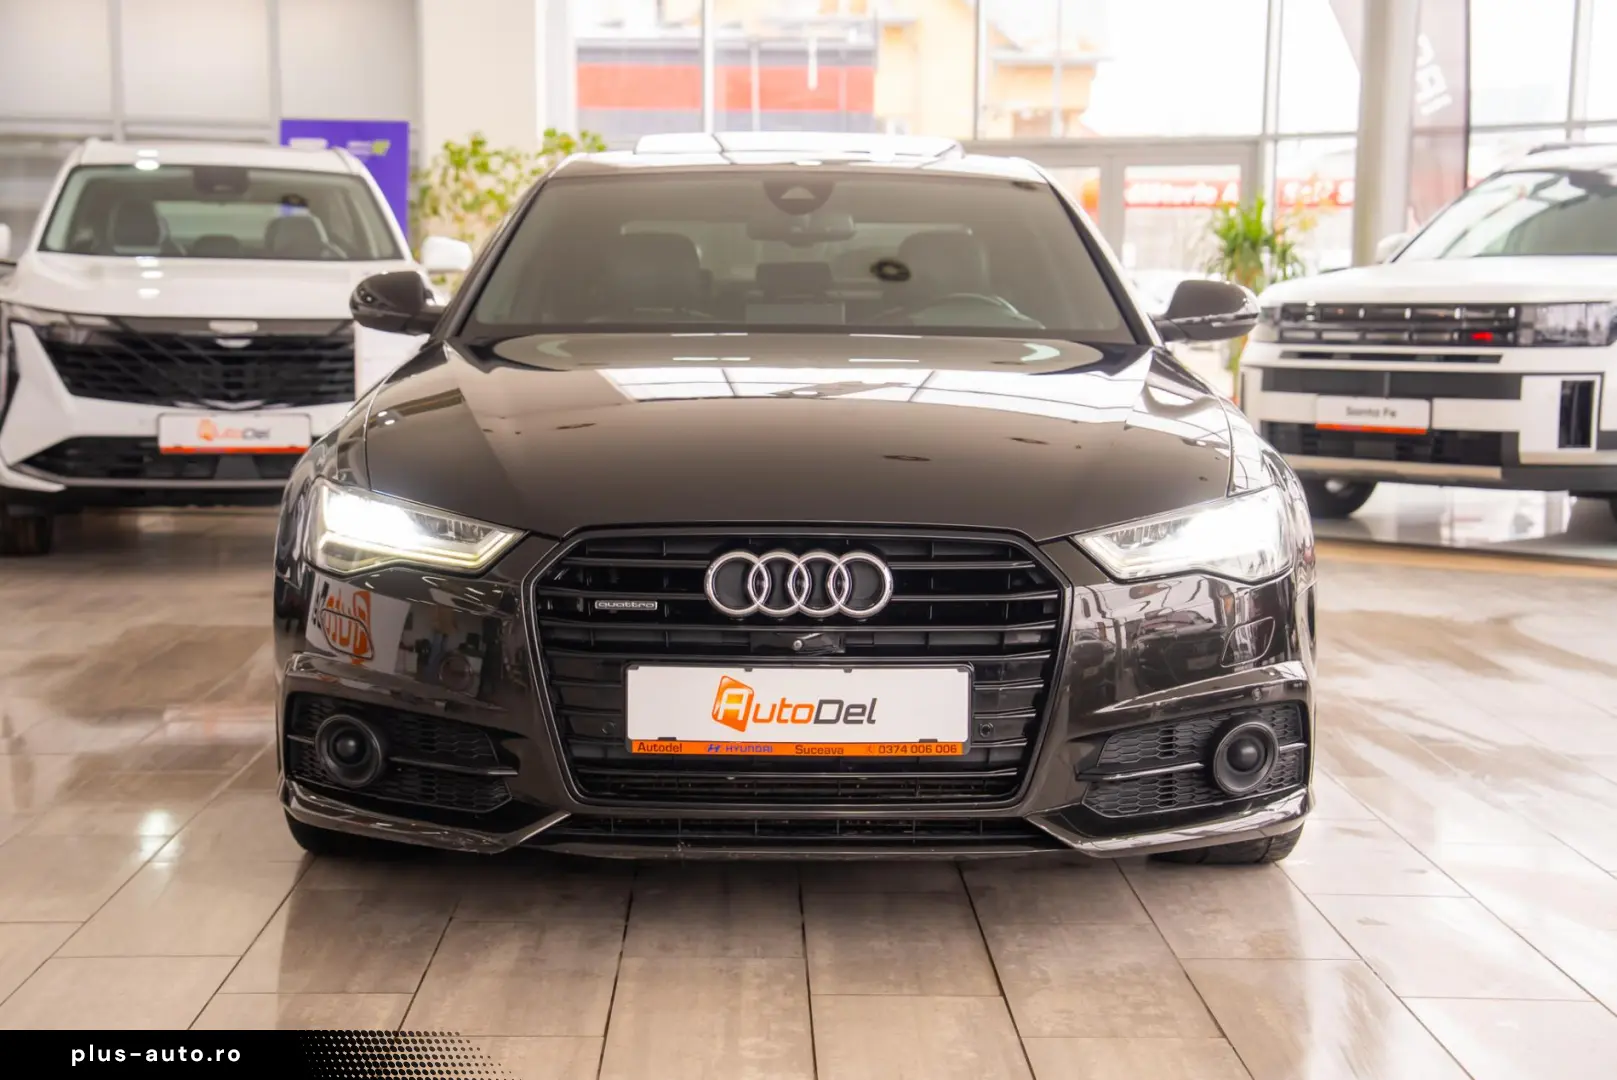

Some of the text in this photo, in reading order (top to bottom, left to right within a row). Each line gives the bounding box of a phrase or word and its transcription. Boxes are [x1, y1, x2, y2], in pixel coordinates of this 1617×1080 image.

[711, 675, 877, 732] AutoDel
[637, 742, 957, 755] Autodel HYUNDAI Suceava 0374 006 006
